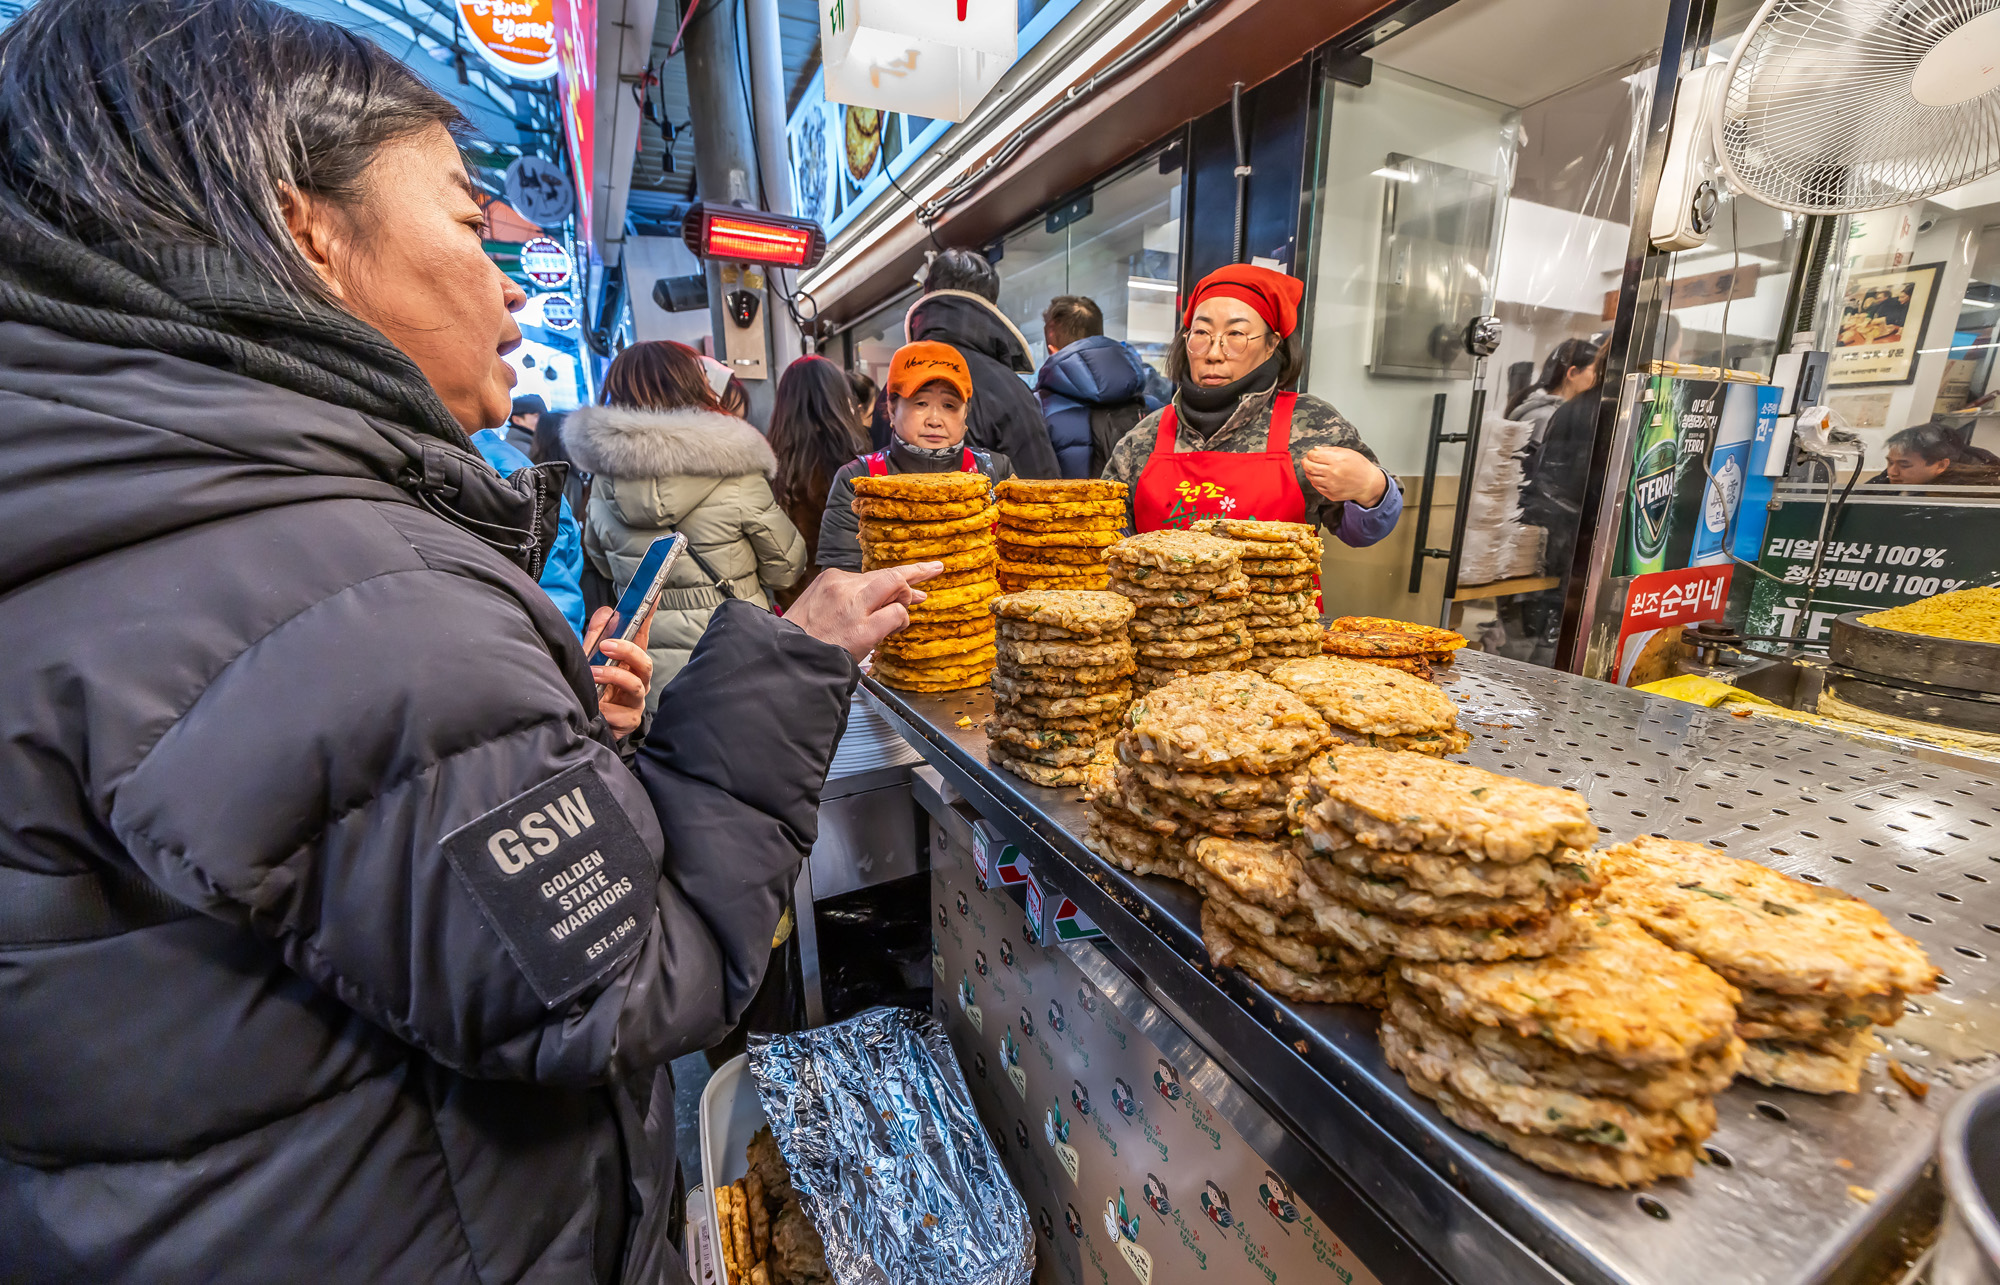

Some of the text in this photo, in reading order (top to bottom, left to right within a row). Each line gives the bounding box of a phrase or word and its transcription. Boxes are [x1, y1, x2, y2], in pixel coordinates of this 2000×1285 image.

[1684, 438, 1705, 454] TERRA
[1175, 480, 1226, 502] 원조
[1638, 471, 1674, 509] TERRA
[1875, 545, 1947, 568] 100%
[487, 787, 596, 876] GSW
[540, 850, 605, 899] GOLDEN
[558, 870, 609, 911] STATE
[550, 876, 633, 940] WARRIORS
